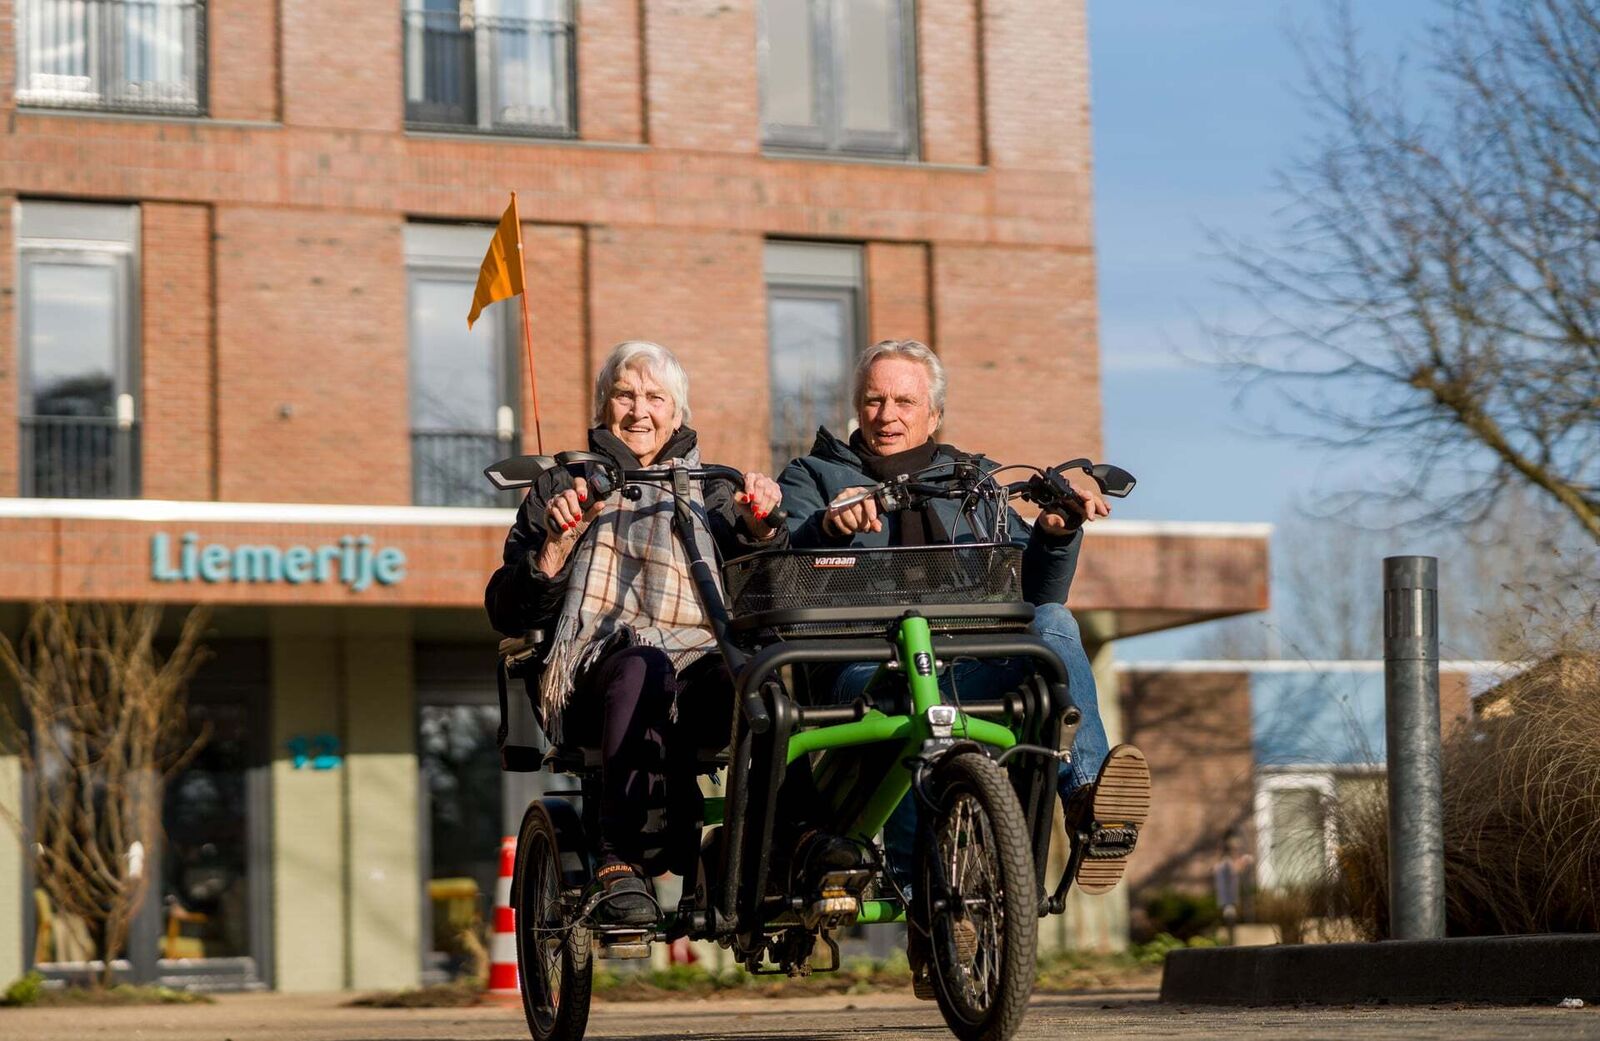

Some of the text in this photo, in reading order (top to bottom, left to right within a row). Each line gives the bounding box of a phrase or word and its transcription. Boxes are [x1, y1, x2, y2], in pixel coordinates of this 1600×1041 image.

[151, 532, 407, 592] Liemerije
[814, 556, 857, 565] vanraam
[286, 735, 343, 770] 12
